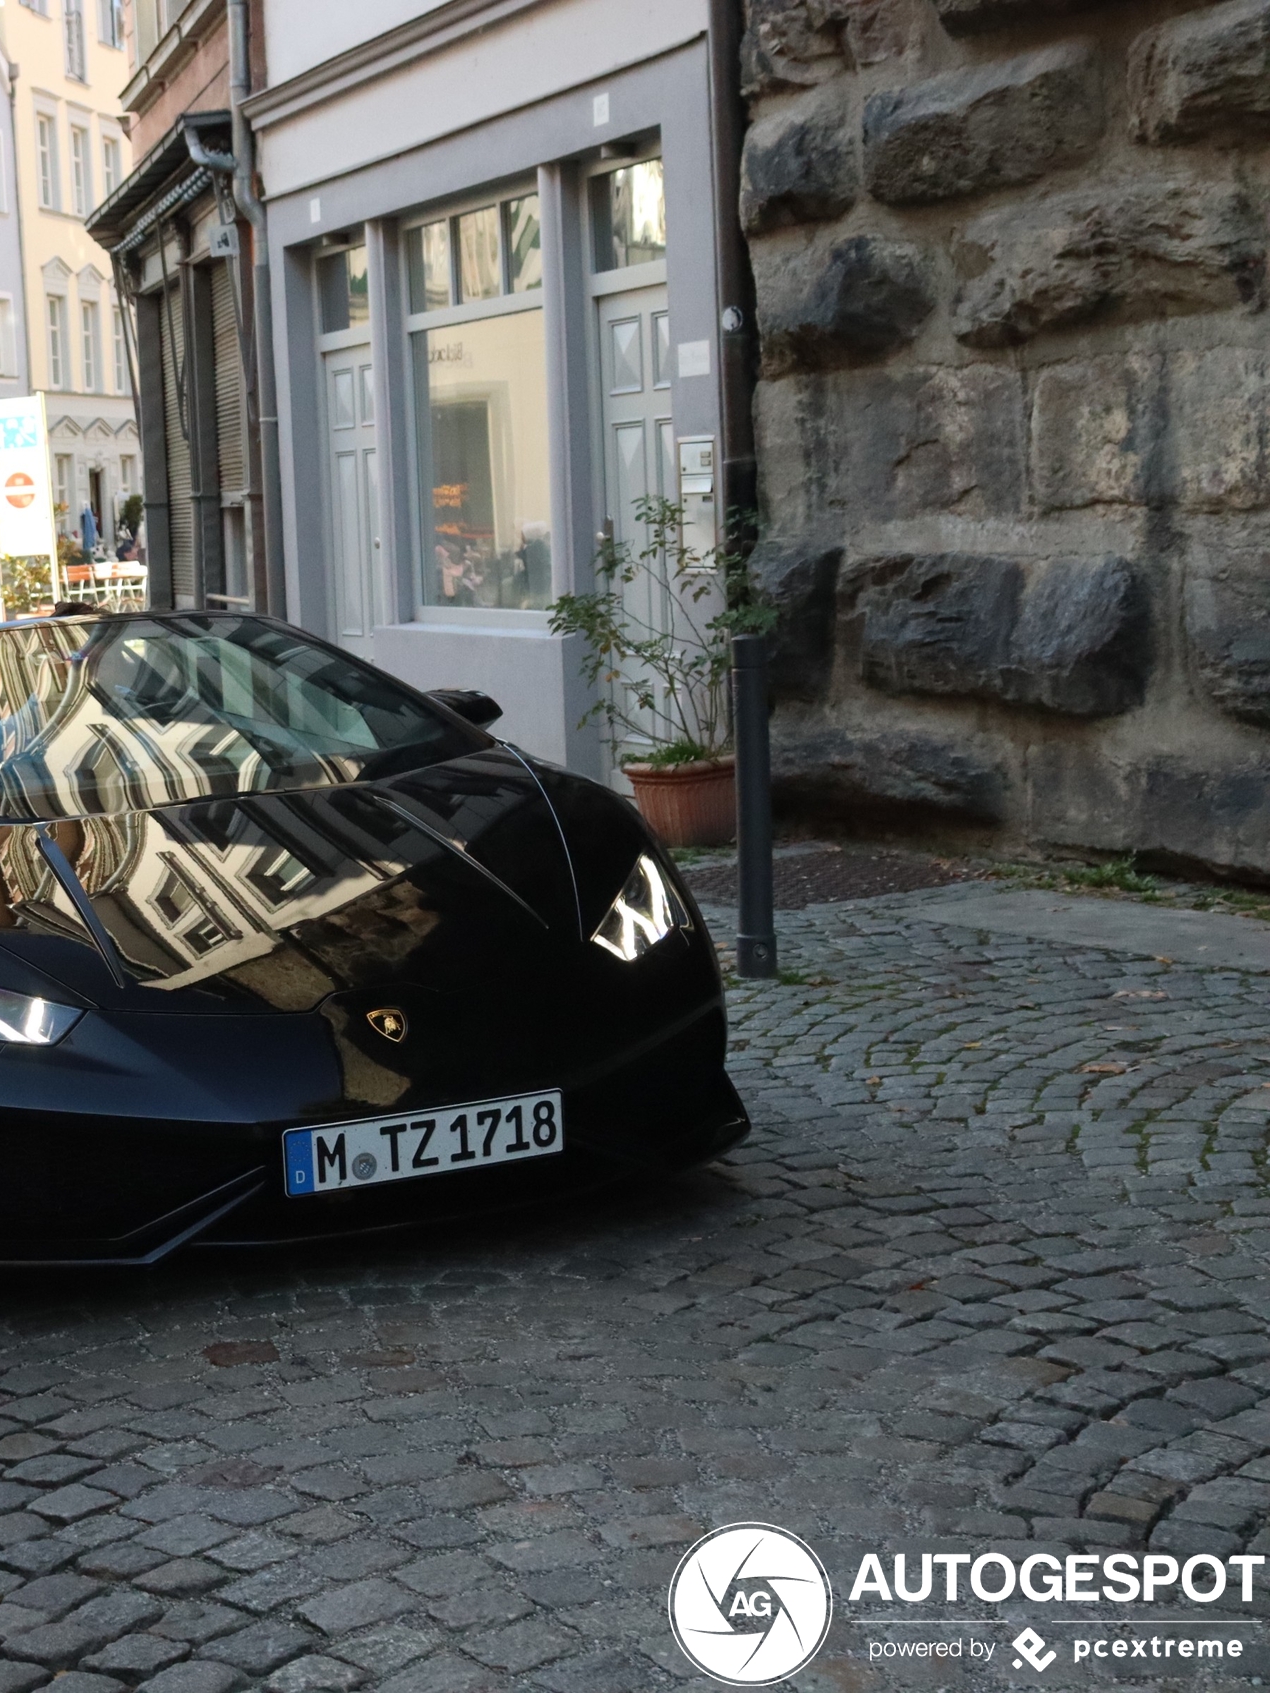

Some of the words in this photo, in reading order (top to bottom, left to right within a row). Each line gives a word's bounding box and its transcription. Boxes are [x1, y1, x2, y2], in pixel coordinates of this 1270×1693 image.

[316, 1132, 347, 1184] M
[380, 1118, 439, 1173] TZ
[450, 1099, 557, 1163] 1718
[295, 1170, 306, 1184] D
